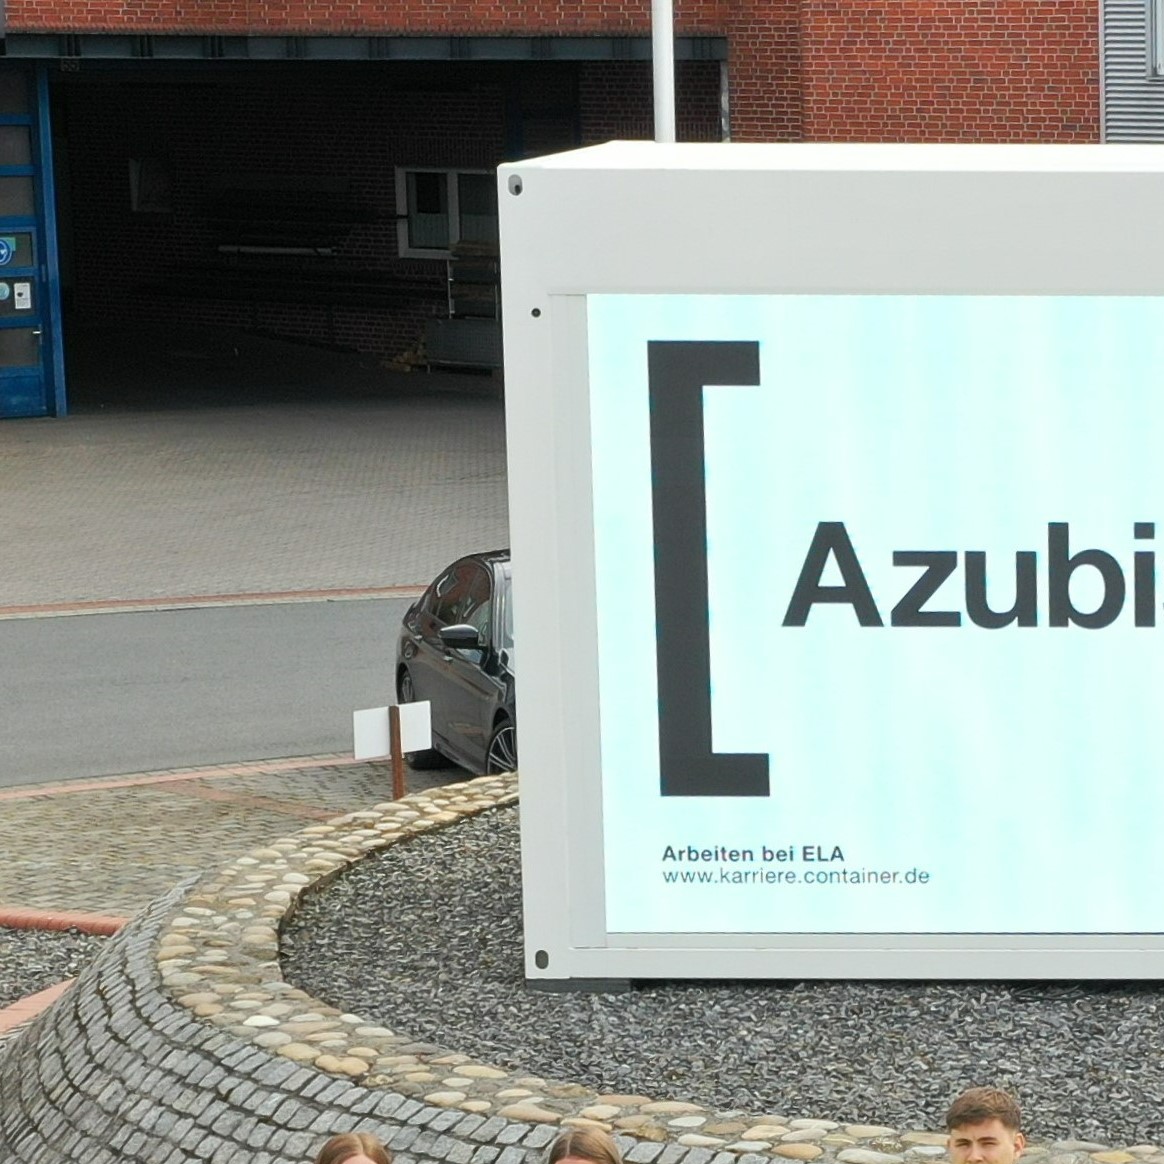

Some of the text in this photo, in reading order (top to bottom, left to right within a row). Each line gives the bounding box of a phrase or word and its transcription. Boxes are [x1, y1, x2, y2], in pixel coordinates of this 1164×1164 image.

[662, 845, 845, 862] Arbeiten bei ELA
[662, 867, 930, 884] www.karriere.container.de
